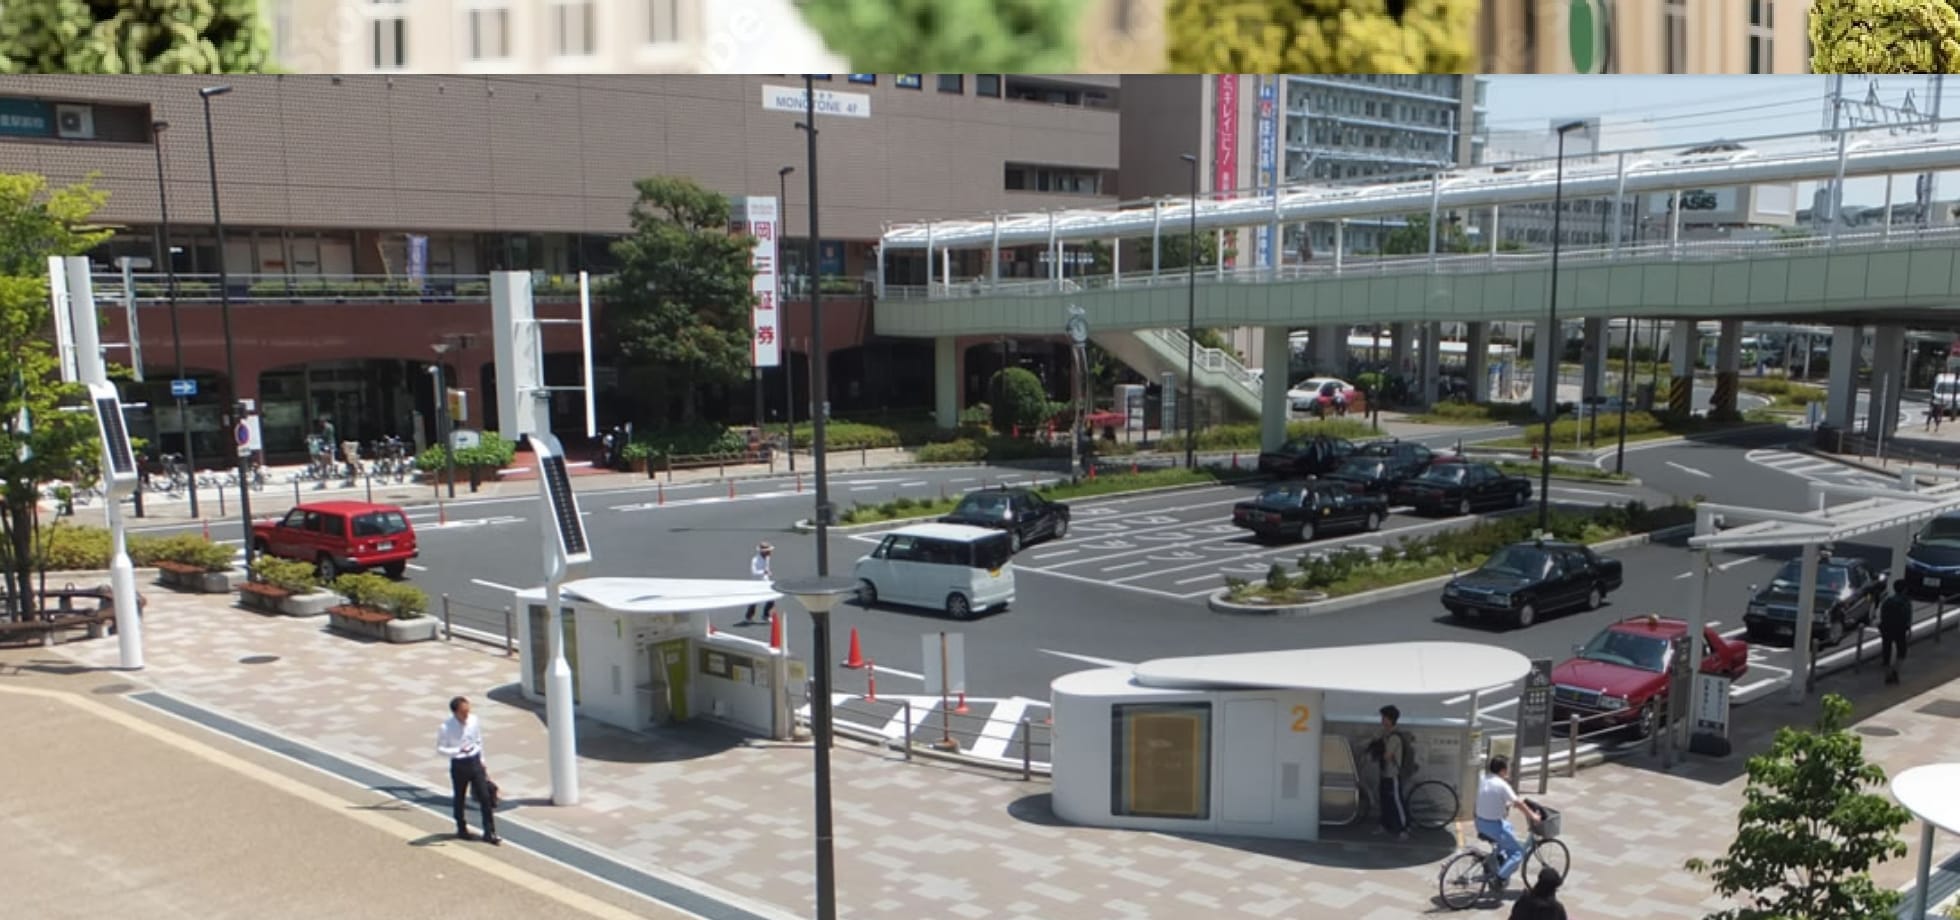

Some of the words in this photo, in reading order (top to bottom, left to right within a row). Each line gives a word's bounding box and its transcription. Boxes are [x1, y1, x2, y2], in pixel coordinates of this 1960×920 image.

[775, 96, 842, 113] MONOONE
[754, 221, 775, 345] 岡三証券
[1290, 704, 1312, 732] 2
